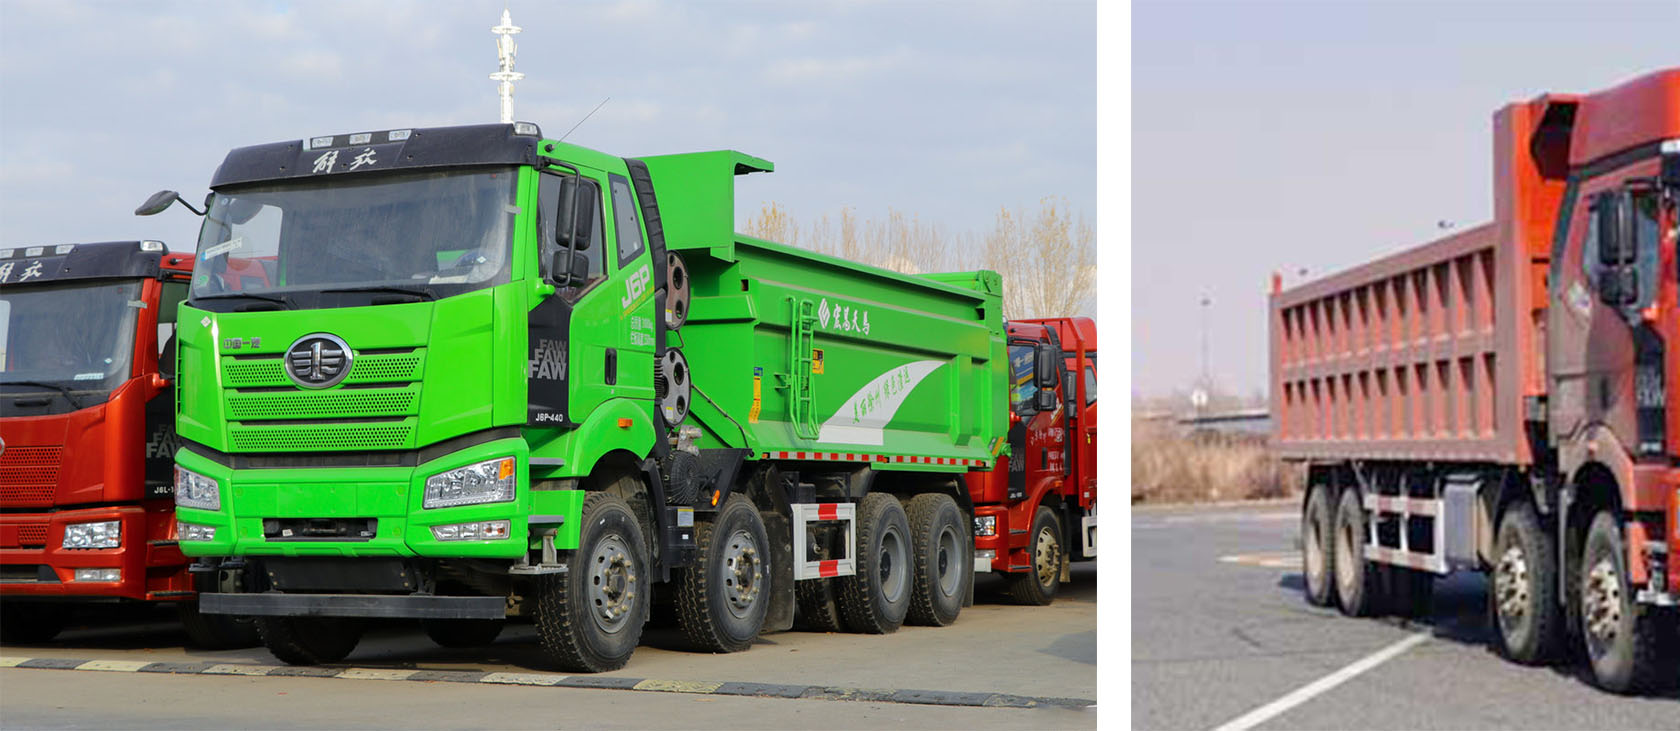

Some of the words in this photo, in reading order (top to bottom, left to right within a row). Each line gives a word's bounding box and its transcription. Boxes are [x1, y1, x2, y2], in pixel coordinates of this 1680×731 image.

[312, 147, 377, 174] 解放
[621, 264, 650, 309] J6P
[528, 360, 567, 381] FAW
[535, 412, 564, 422] J6P-440
